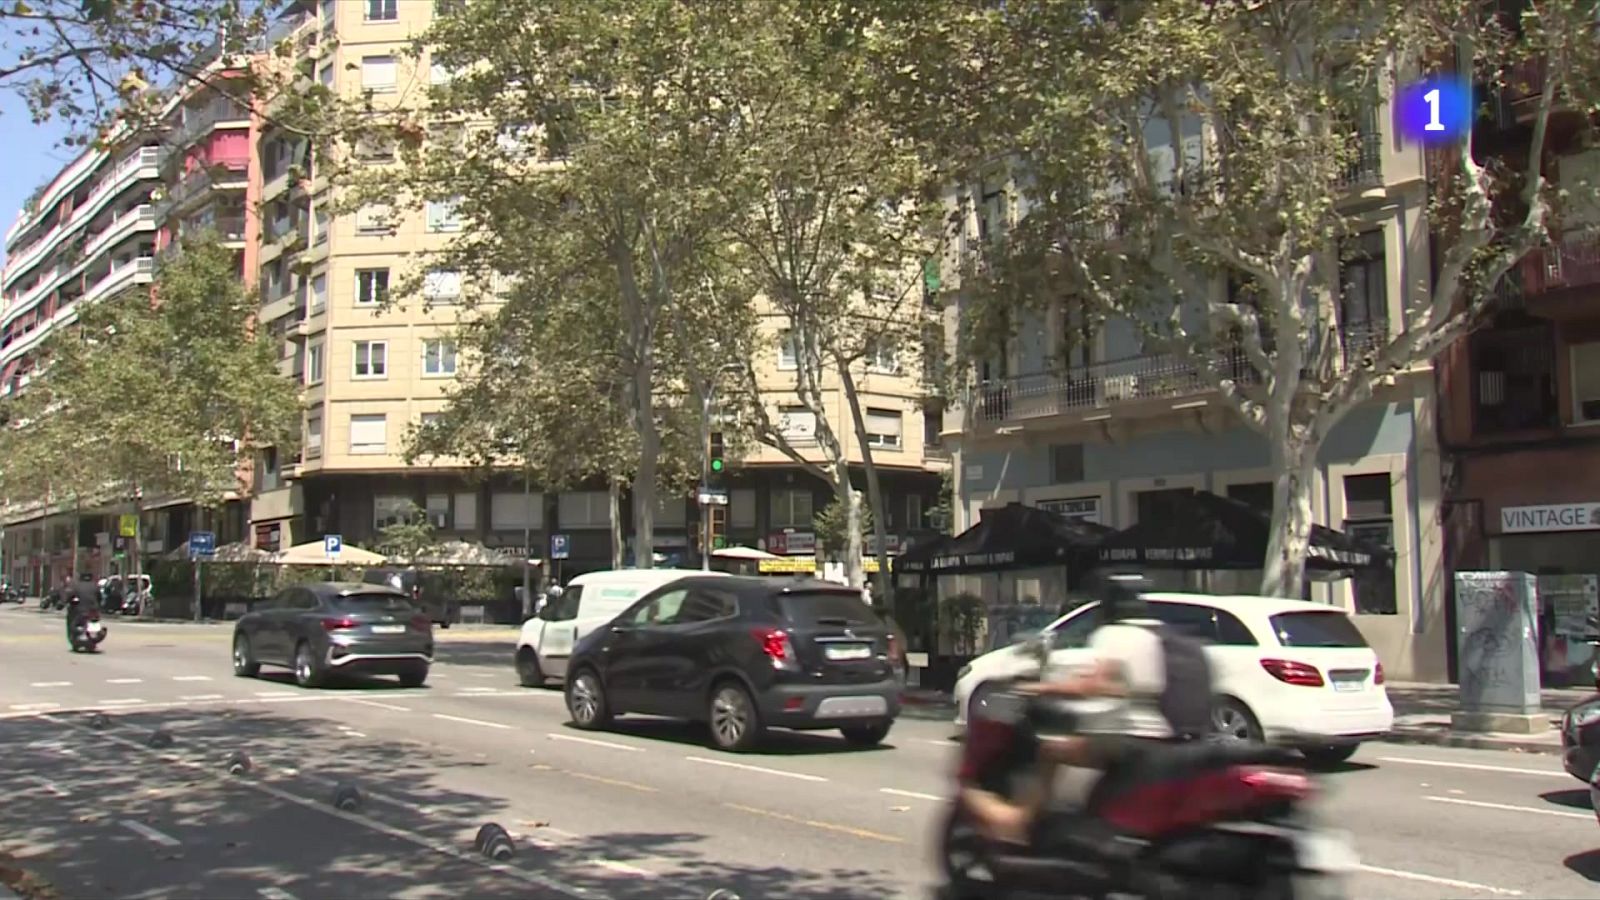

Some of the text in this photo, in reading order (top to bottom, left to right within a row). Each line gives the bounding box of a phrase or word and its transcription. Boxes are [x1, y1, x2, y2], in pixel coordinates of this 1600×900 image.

[1503, 507, 1586, 527] VINTAGE
[327, 537, 339, 551] P
[554, 537, 566, 551] P
